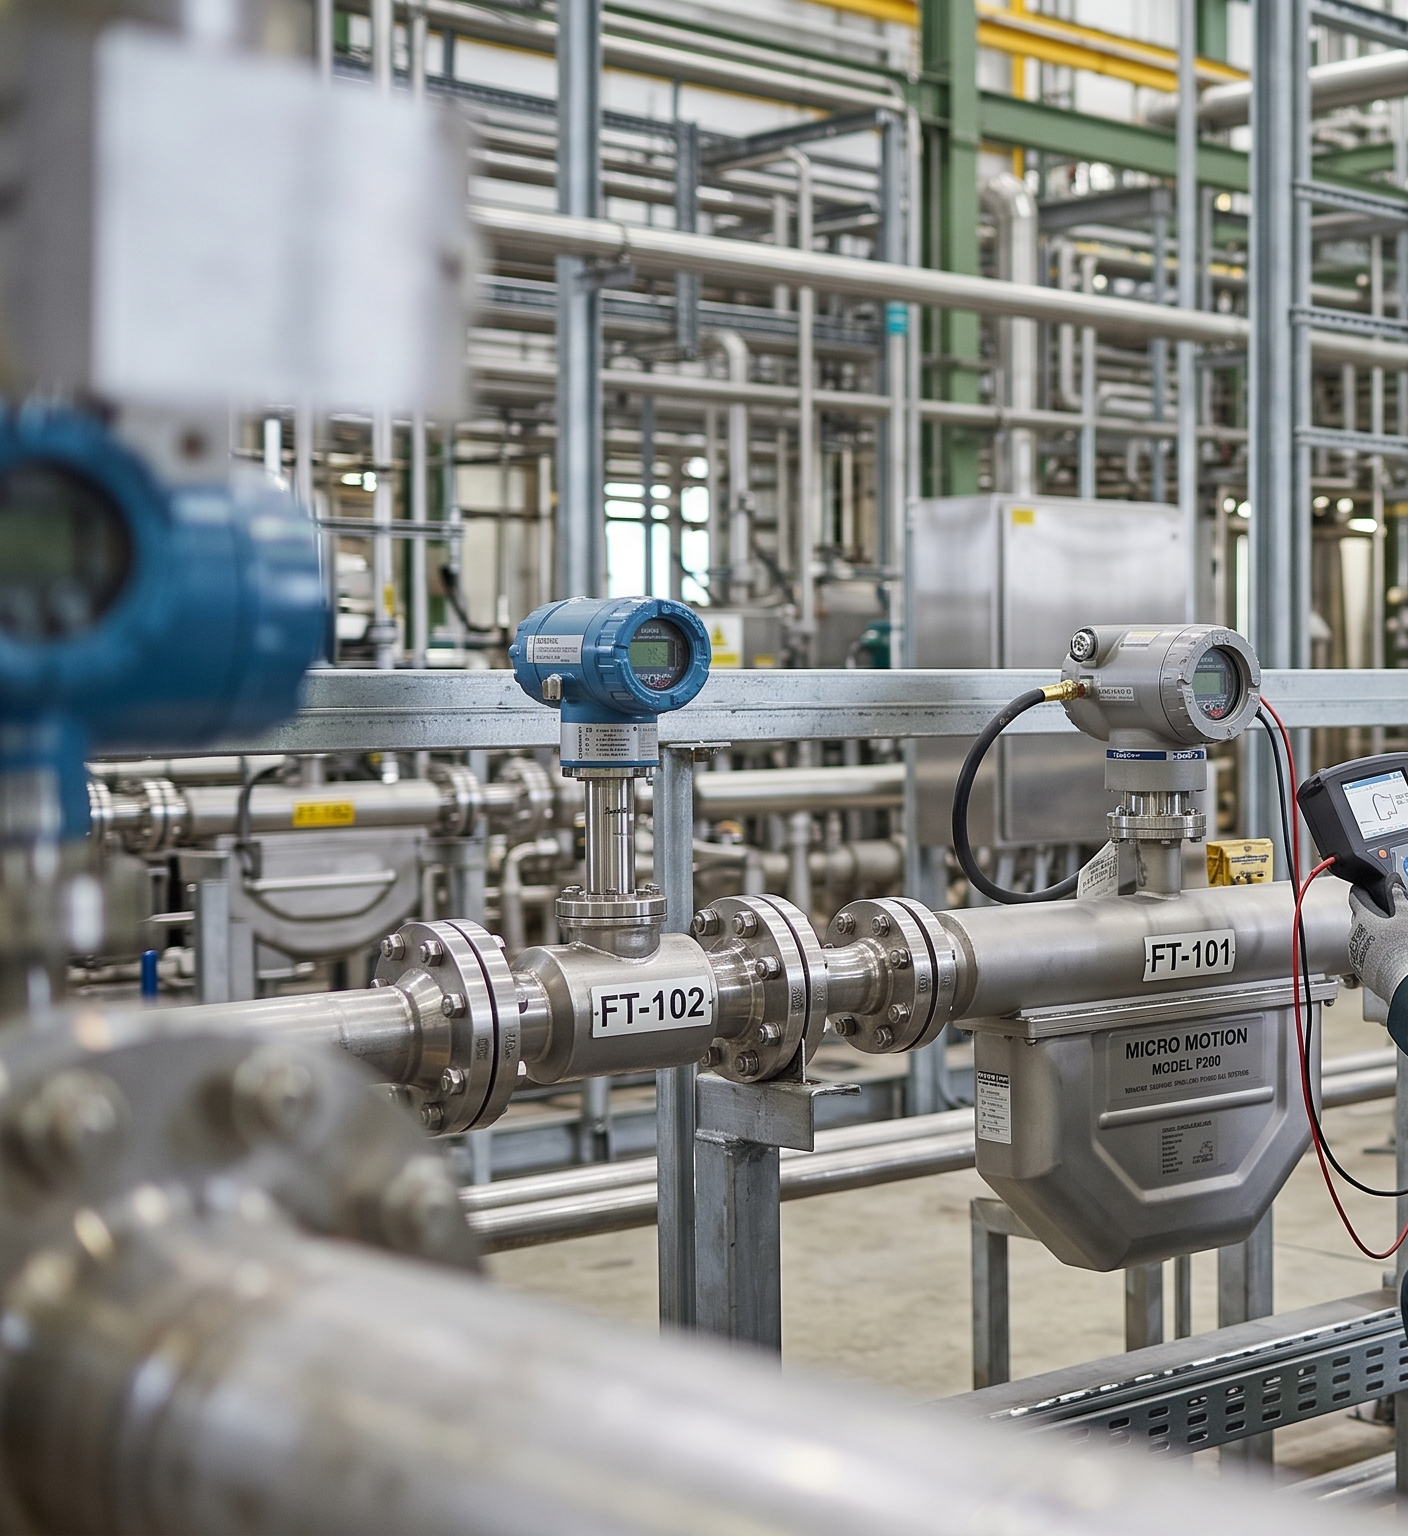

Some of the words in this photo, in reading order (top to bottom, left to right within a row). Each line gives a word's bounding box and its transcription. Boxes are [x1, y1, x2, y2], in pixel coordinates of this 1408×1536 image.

[1151, 938, 1229, 973] FT-101
[600, 986, 705, 1028] FT-102
[1125, 1036, 1180, 1060] MICRO
[1184, 1027, 1248, 1052] MOTION
[1152, 1058, 1193, 1076] MODEL
[1195, 1054, 1221, 1070] P200
